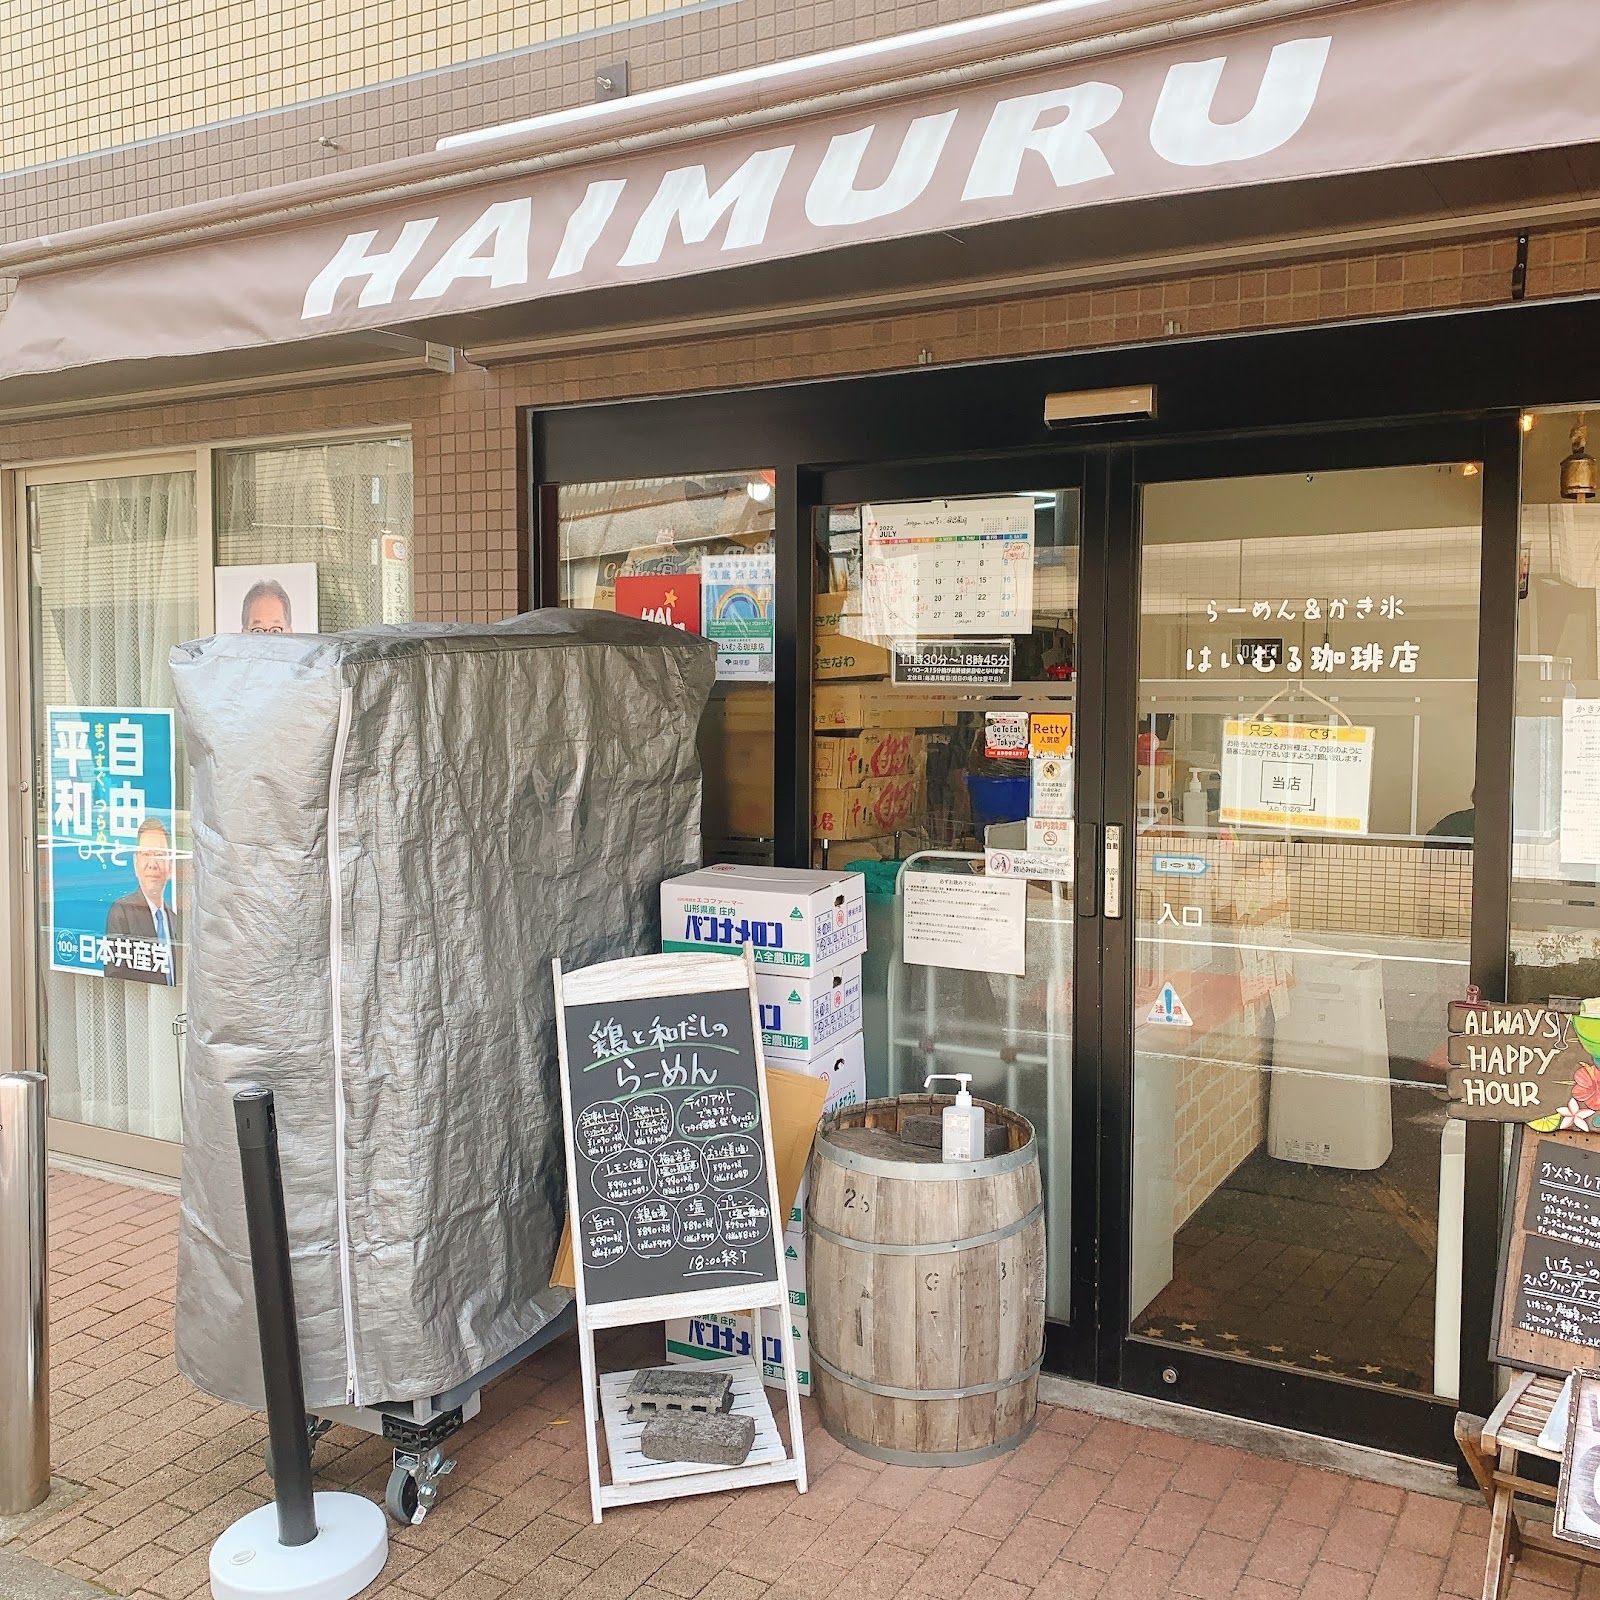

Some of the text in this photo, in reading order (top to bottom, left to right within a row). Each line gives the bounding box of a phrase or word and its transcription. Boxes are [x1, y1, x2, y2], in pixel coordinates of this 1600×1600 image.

[301, 36, 1333, 320] HAIMURU
[979, 576, 987, 584] 15
[933, 611, 942, 619] 27
[977, 610, 986, 618] 29
[1001, 610, 1010, 618] 30
[1206, 594, 1405, 623] らーめん&かき氷
[1186, 640, 1421, 673] はいむる珈琲店
[1234, 644, 1280, 659] TOIET
[992, 725, 1020, 733] Go To Eat
[1033, 723, 1068, 737] Retty
[1040, 736, 1060, 744] 人気店
[997, 738, 1016, 748] Tokyo
[54, 720, 94, 860] 平和の
[108, 718, 146, 867] 自由と
[1271, 776, 1302, 791] 当店
[1106, 842, 1119, 850] 自動
[1106, 867, 1119, 875] PUSH
[683, 904, 736, 916] 山形県産 庄内
[1157, 903, 1203, 927] 入口
[78, 934, 171, 974] 日本共産党
[1465, 1008, 1559, 1038] ALWAYS
[588, 1013, 729, 1059] 鶏と和だしの
[1466, 1044, 1561, 1076] HAPPY
[616, 1052, 718, 1094] らーめん
[683, 1090, 736, 1109] テイクアウト
[1462, 1078, 1541, 1107] HOUR
[688, 1248, 747, 1271] 18:00終了
[1544, 1256, 1600, 1280] いちごの
[1522, 1271, 1600, 1304] スパークリングエス
[720, 1317, 737, 1327] 庄内
